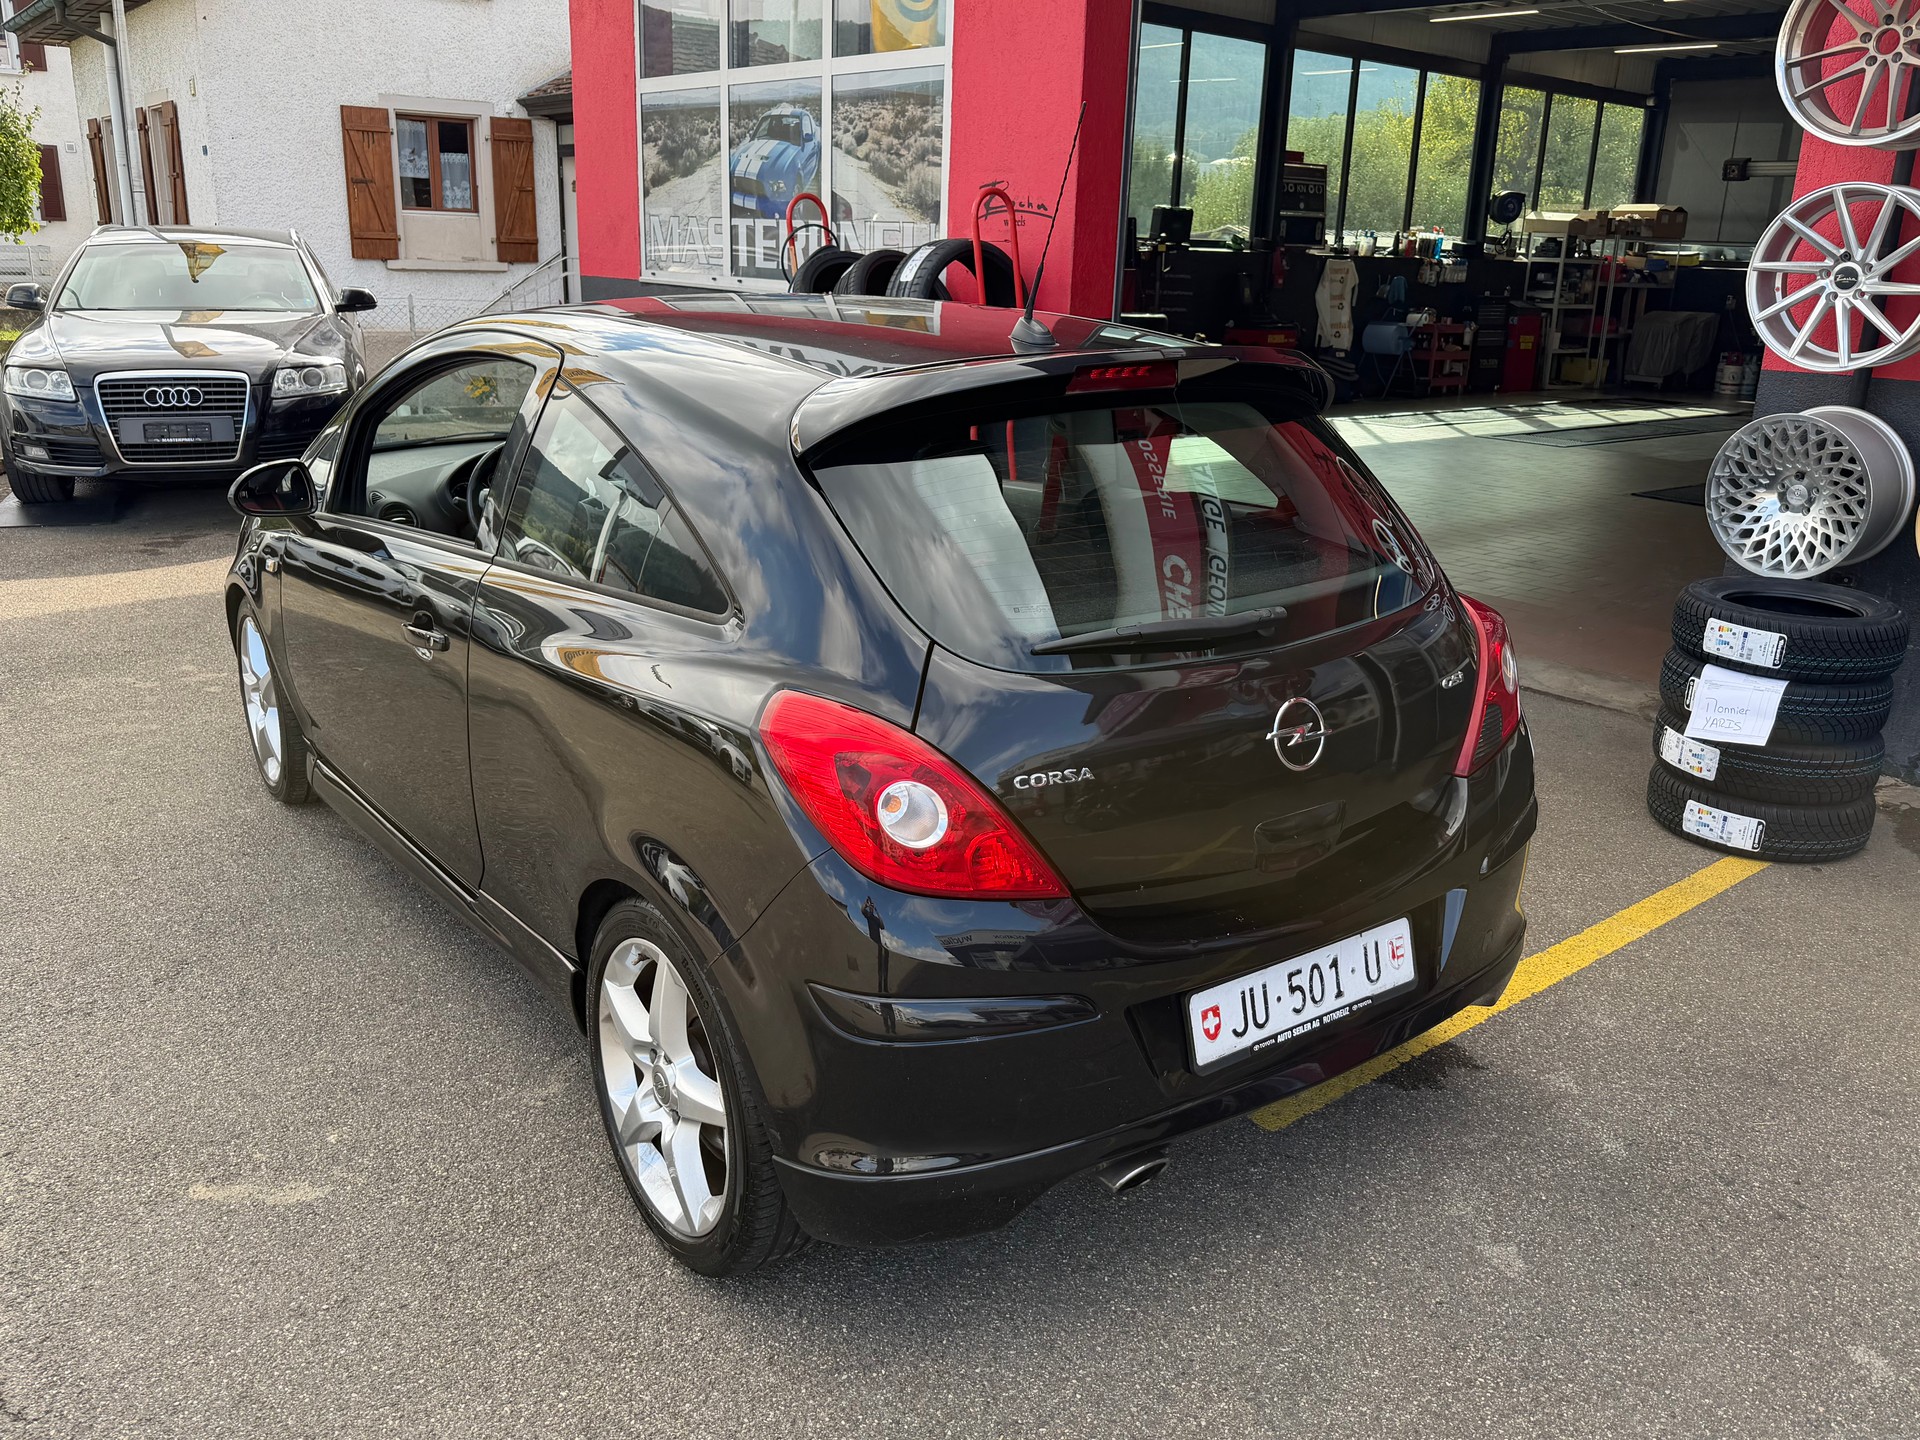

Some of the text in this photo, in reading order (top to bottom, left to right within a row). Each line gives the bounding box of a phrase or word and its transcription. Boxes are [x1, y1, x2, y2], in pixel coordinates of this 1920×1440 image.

[1705, 716, 1742, 731] YARIS
[1013, 767, 1095, 789] CORSA
[1277, 1031, 1292, 1043] AUTO
[1292, 1022, 1311, 1037] SEILER
[1312, 1019, 1320, 1030] AG
[1322, 1007, 1350, 1025] ROTKREUZ
